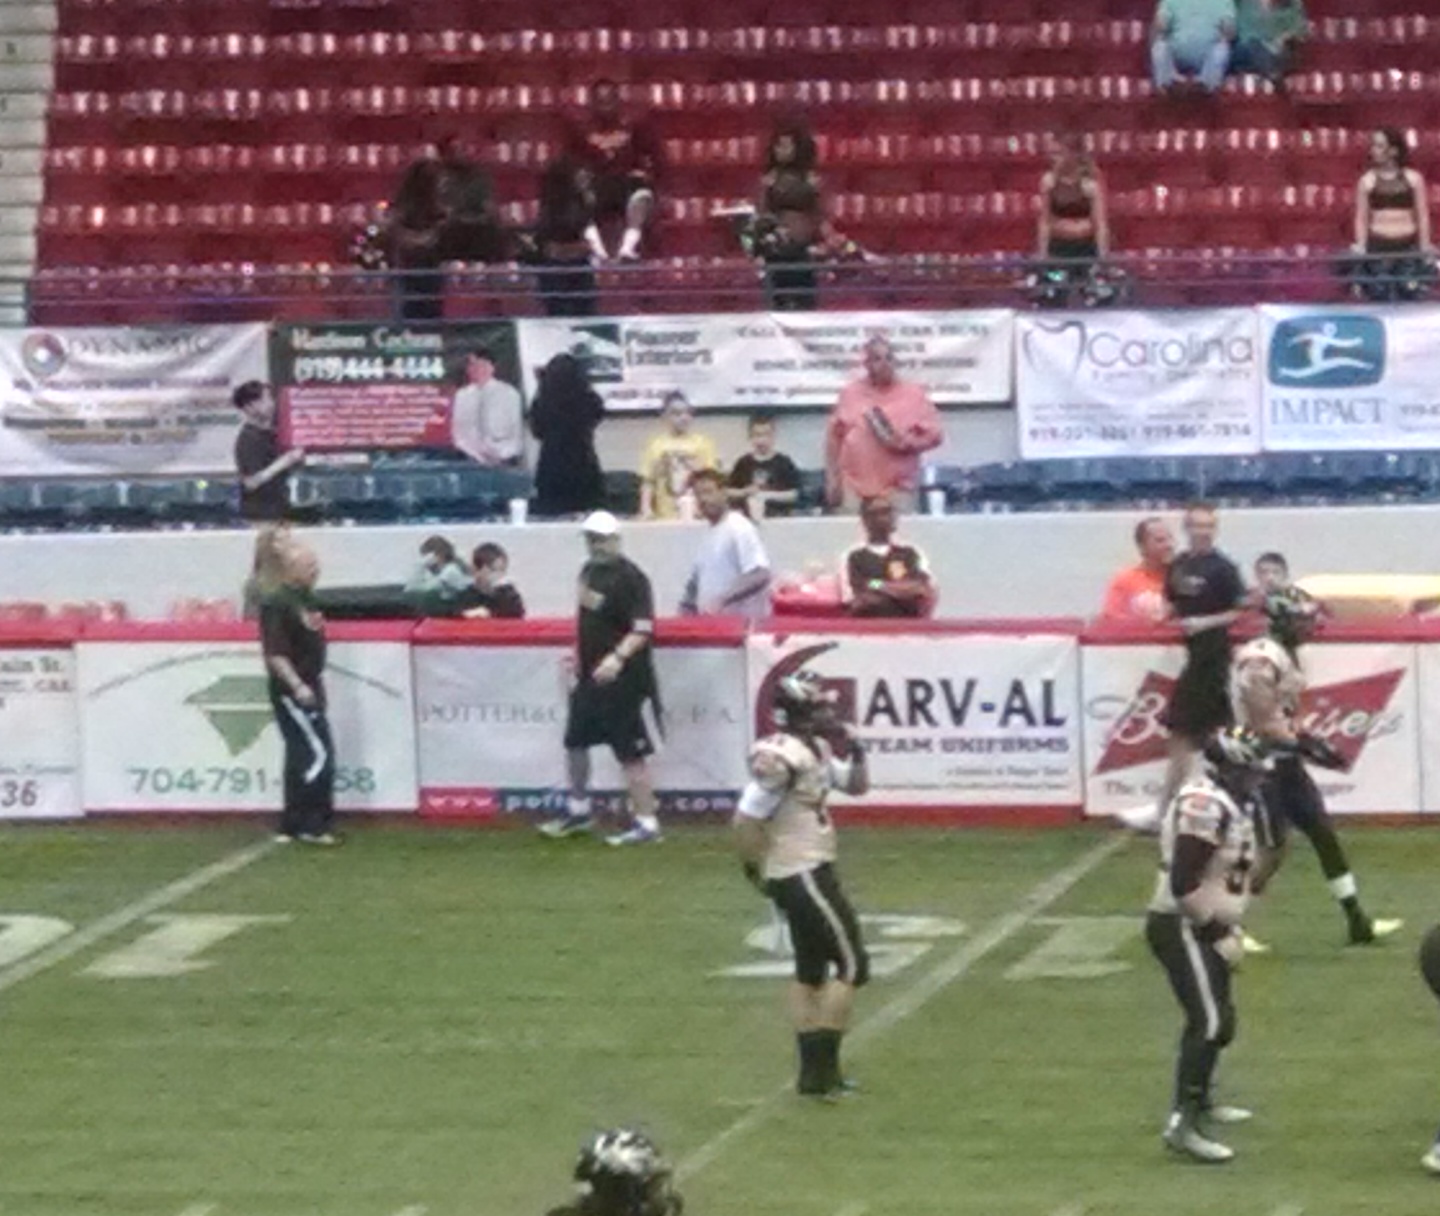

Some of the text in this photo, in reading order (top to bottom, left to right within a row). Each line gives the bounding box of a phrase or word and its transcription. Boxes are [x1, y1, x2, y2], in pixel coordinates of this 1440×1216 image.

[1088, 331, 1253, 368] Carolina
[1270, 398, 1384, 425] IMPACT
[940, 736, 1070, 754] UNIFORMS
